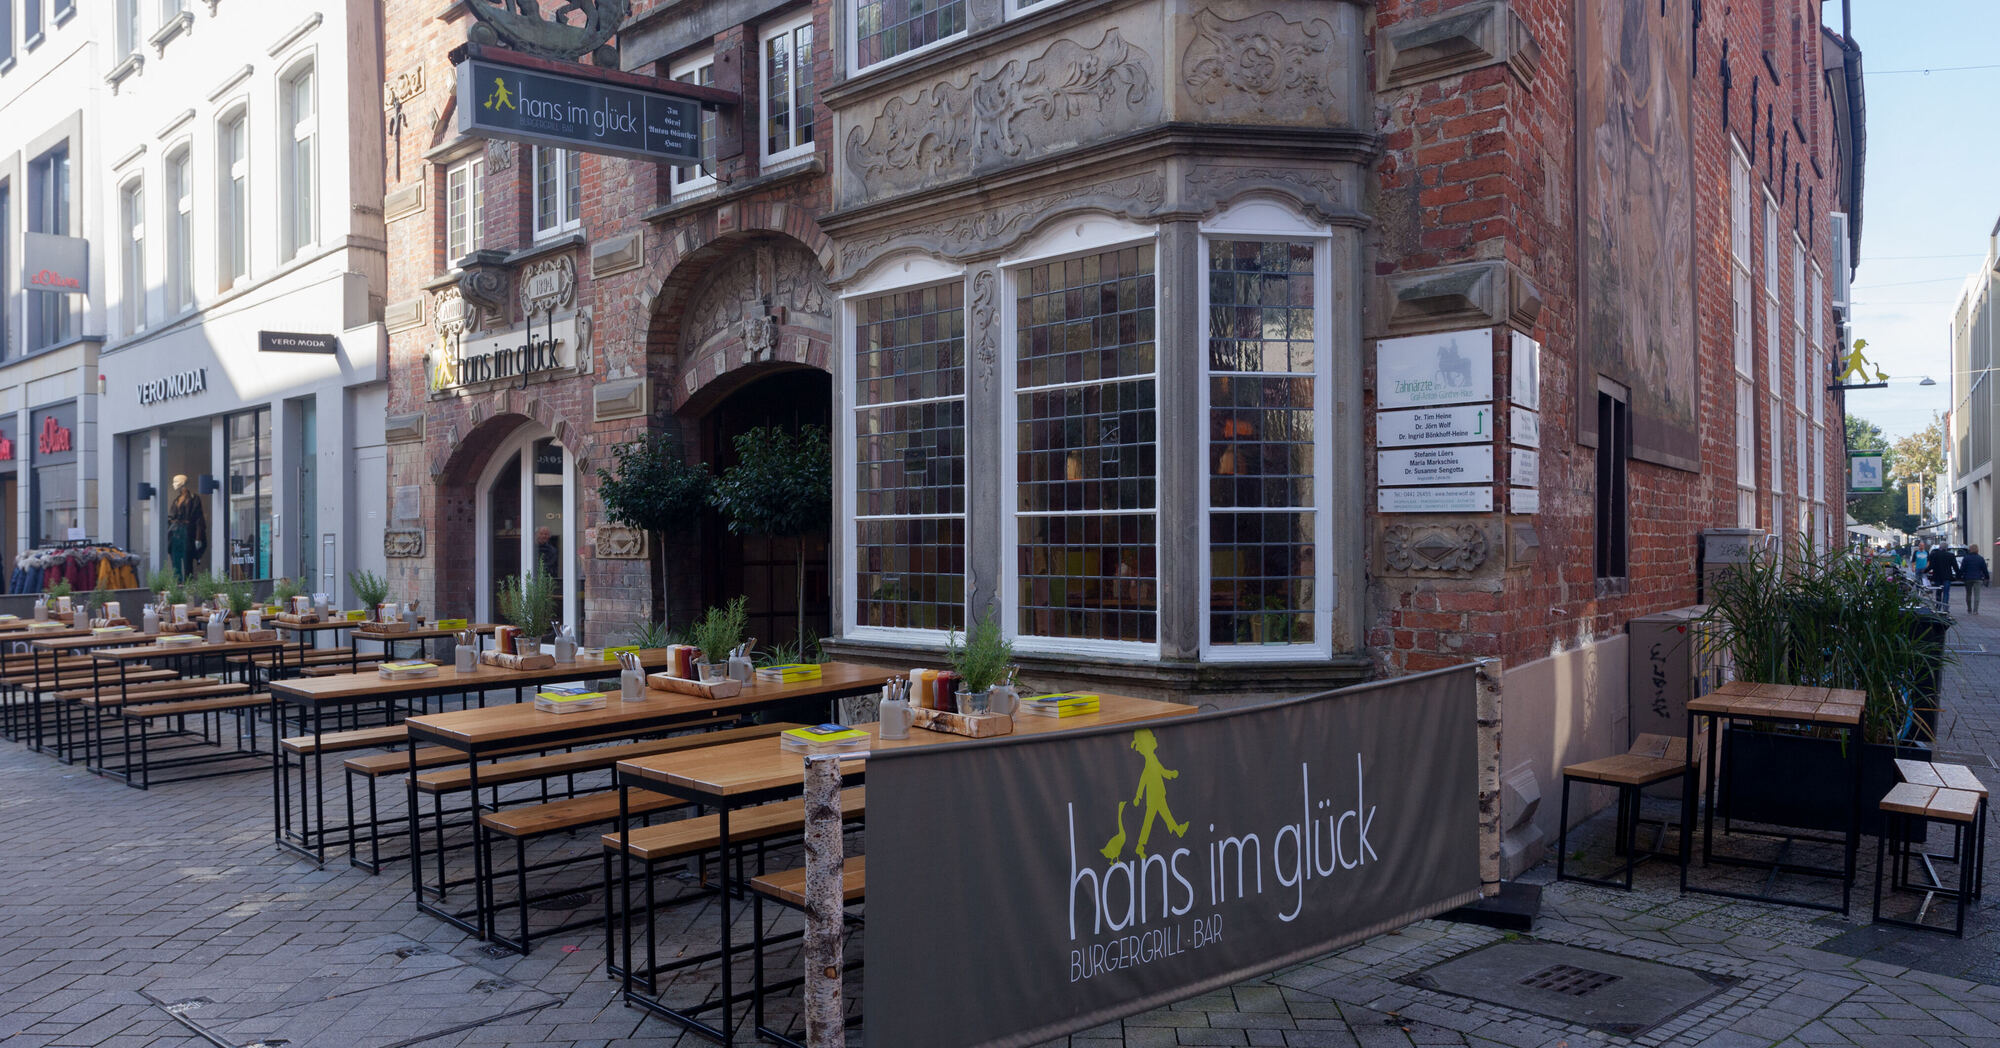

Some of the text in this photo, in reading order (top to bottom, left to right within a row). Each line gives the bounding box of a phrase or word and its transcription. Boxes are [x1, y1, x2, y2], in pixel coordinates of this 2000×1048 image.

[519, 81, 637, 137] hans im glück
[271, 338, 326, 347] VERO MODA
[456, 310, 559, 390] hans im glück
[136, 367, 207, 404] VERO MODA
[1394, 378, 1433, 394] Zahnärzte
[1435, 412, 1452, 420] Heine
[1424, 422, 1438, 430] Jörn
[1408, 432, 1424, 441] Ingrid
[1425, 430, 1468, 439] Bönkhoff-Heine
[1414, 450, 1436, 458] Stefanie
[1426, 458, 1458, 466] Markschies
[1414, 467, 1437, 475] Susanne
[1438, 466, 1464, 475] Sengotta
[1068, 752, 1378, 941] hans im glück
[1070, 914, 1223, 983] BURGERGRILL BAR
